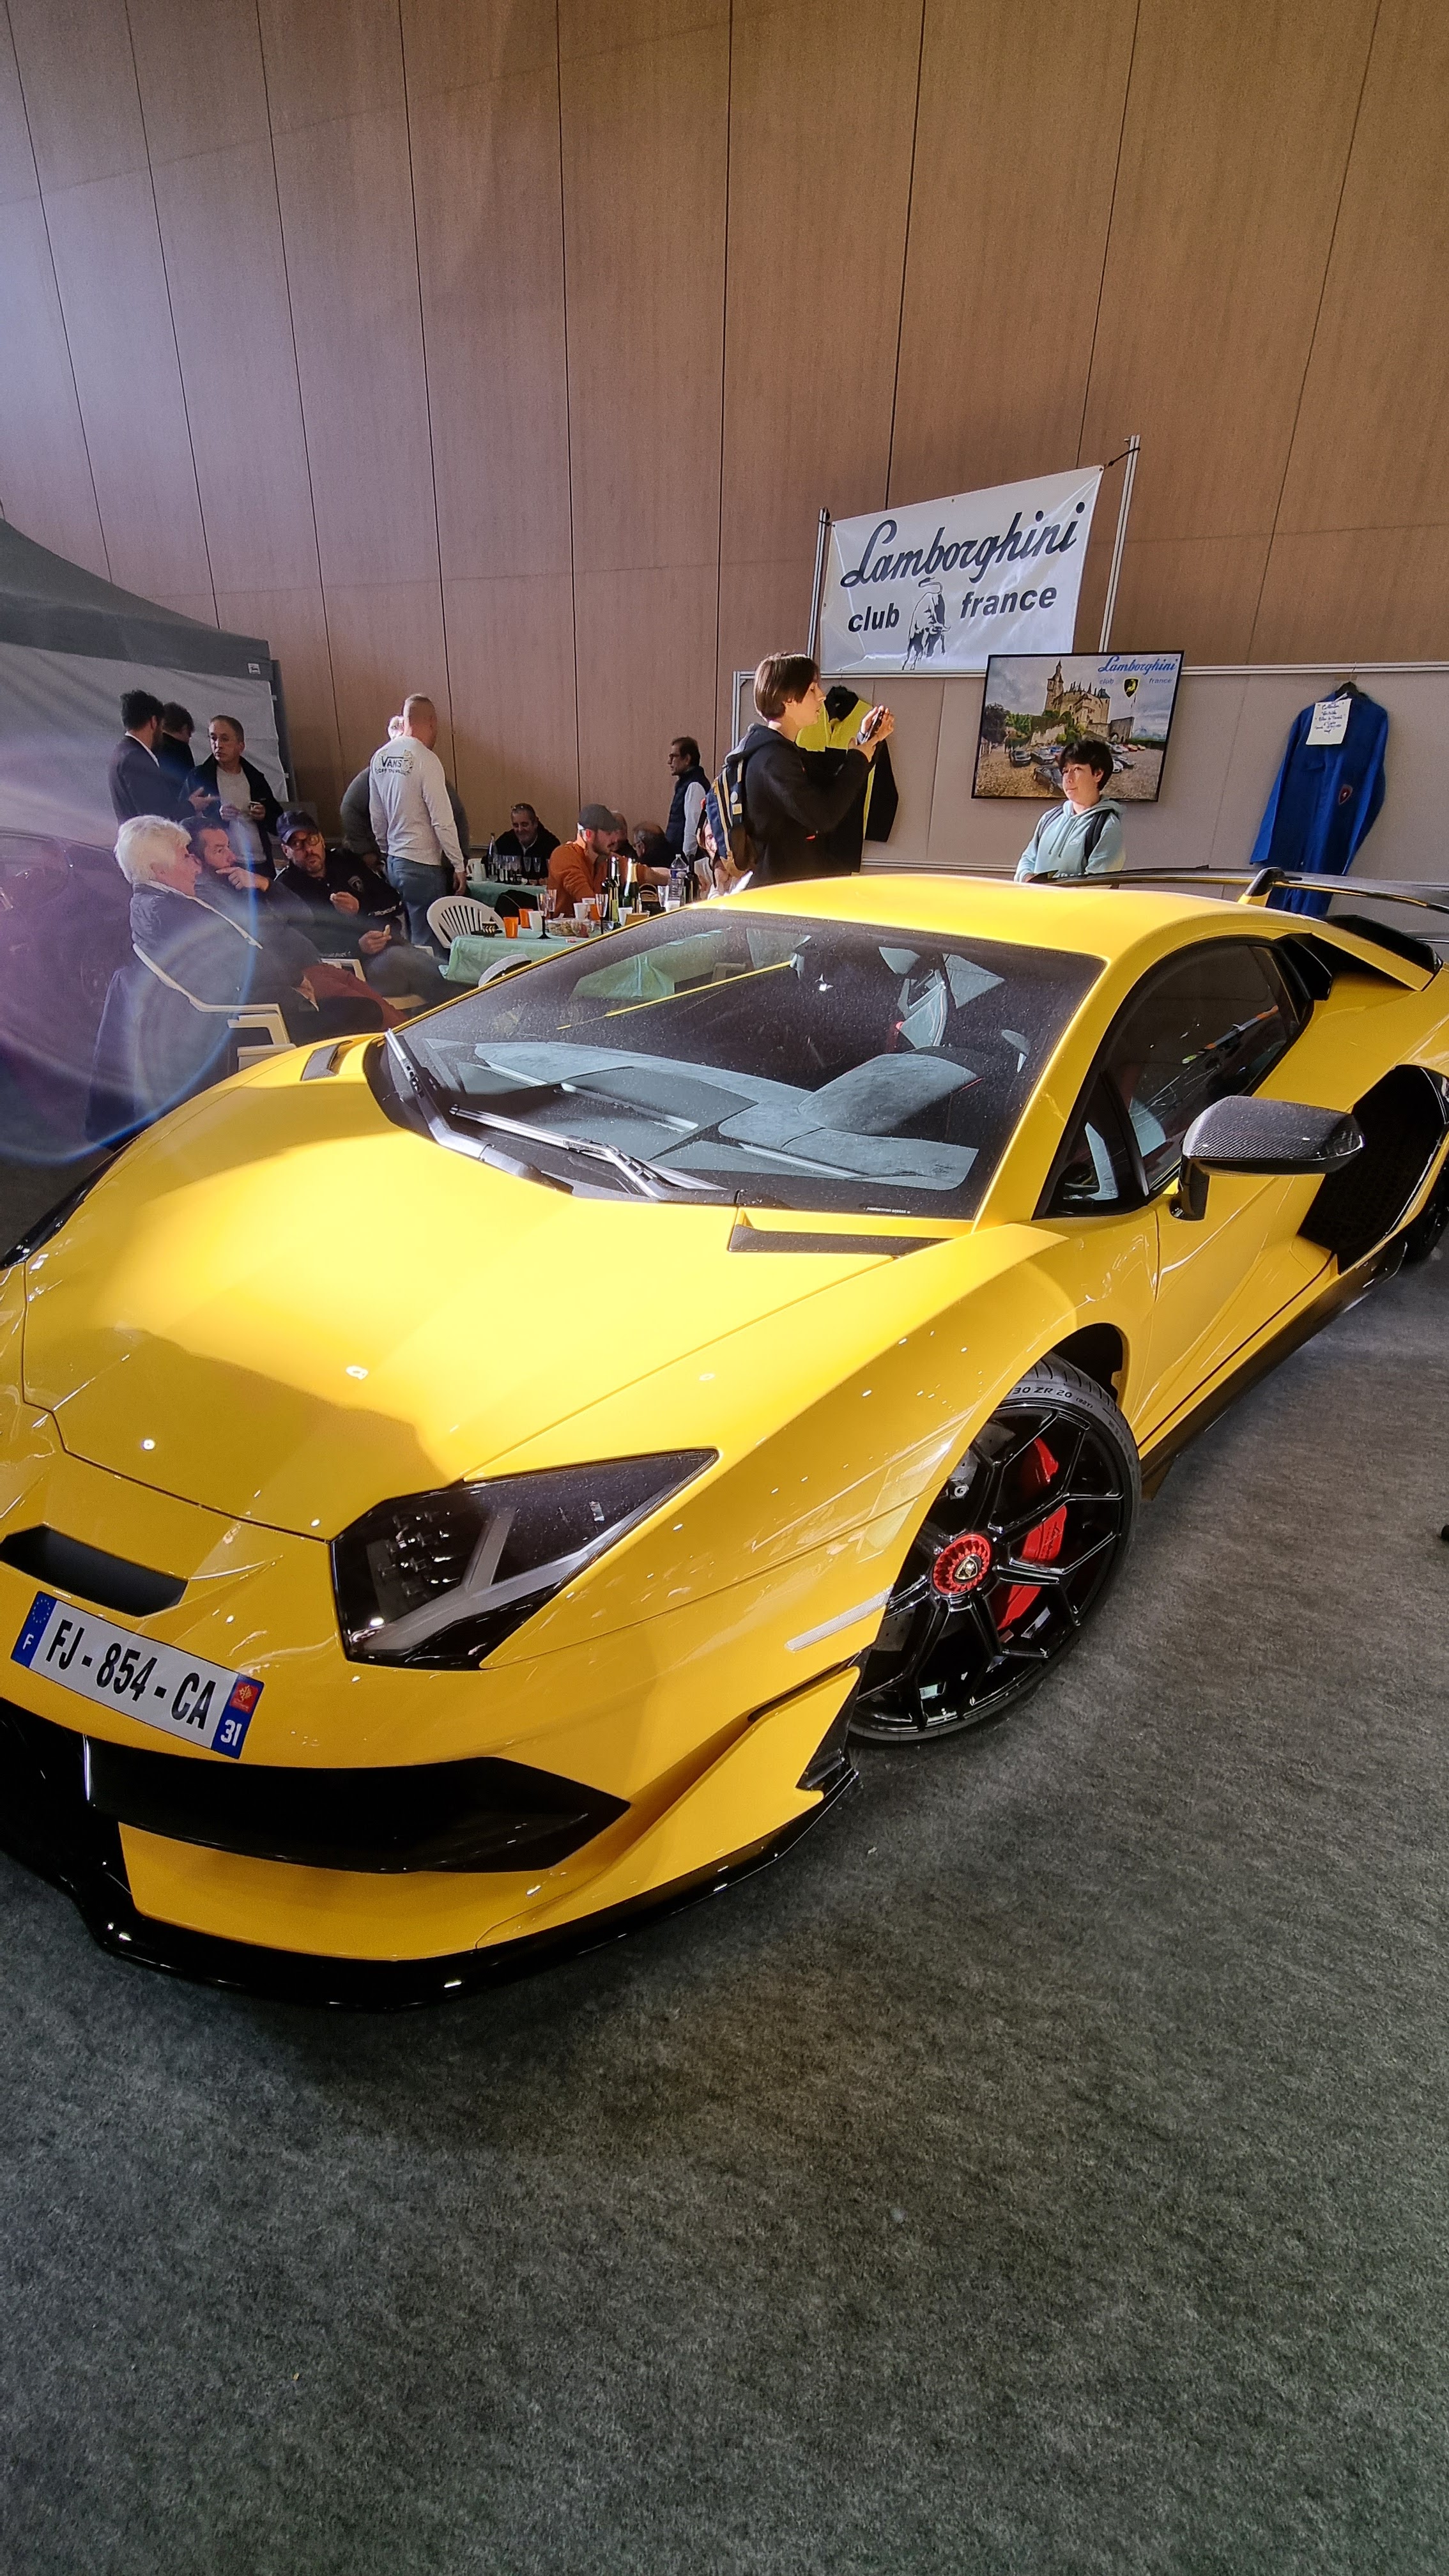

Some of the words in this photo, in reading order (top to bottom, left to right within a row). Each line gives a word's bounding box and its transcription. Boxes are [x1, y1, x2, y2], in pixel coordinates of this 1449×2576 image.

[840, 502, 1085, 588] Lamborghini
[848, 603, 900, 632] club
[960, 586, 1057, 618] france
[1098, 656, 1178, 675] Lamborghini
[381, 756, 404, 767] VANS
[1056, 1389, 1073, 1398] 20
[22, 1634, 34, 1650] F
[220, 1719, 243, 1747] 31
